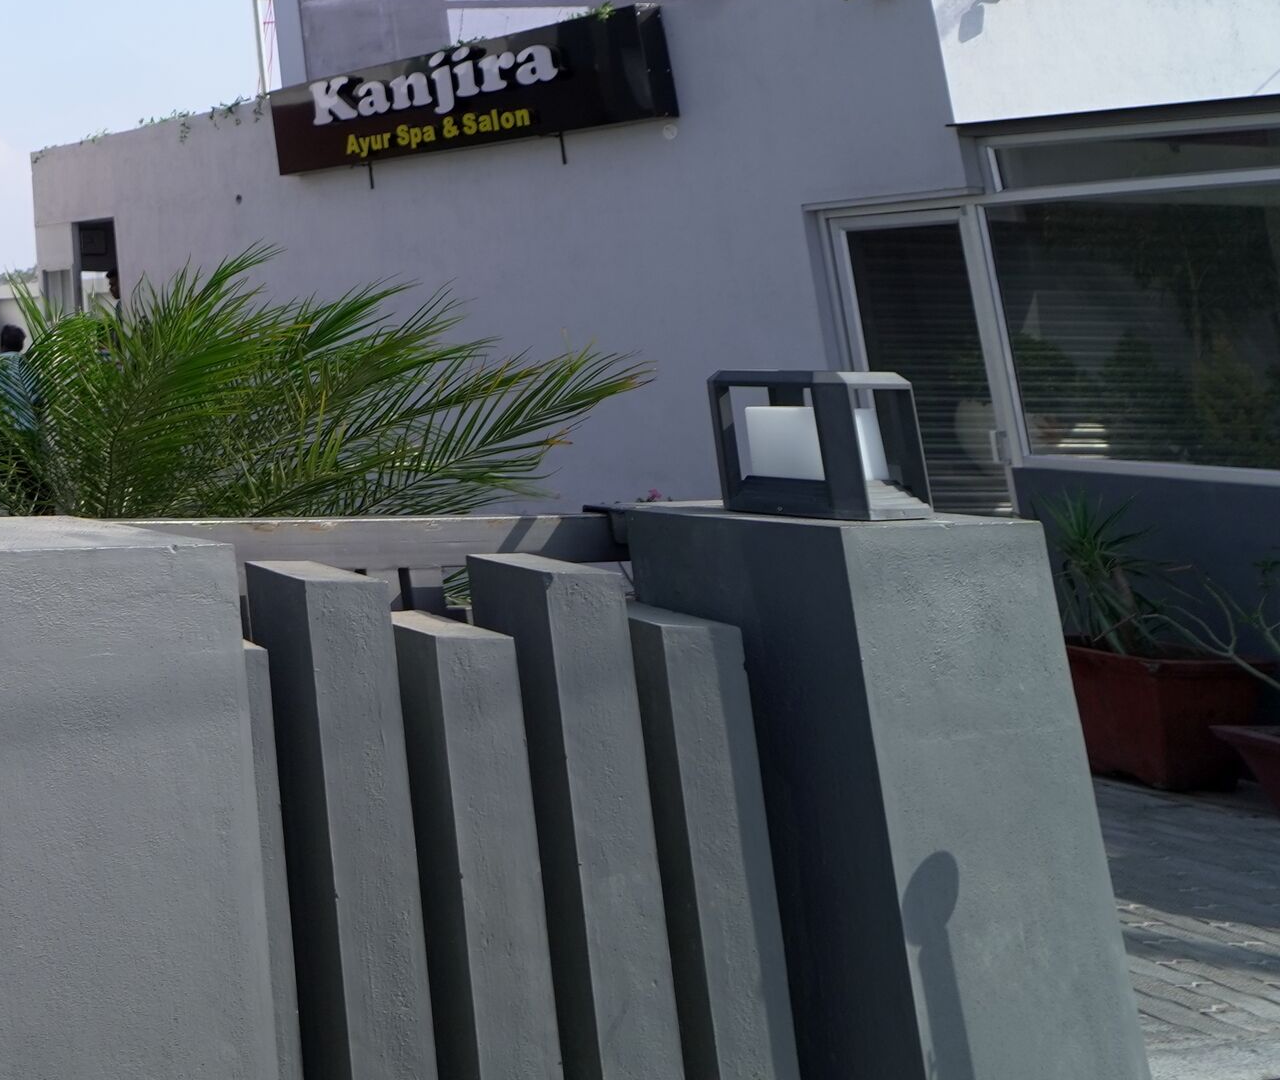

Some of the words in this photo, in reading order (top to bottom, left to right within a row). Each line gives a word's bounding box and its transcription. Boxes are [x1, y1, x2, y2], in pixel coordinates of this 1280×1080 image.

[309, 44, 559, 126] Kanjira
[346, 132, 392, 158] Ayur
[396, 123, 437, 150] Spa
[442, 117, 460, 139] &
[463, 107, 531, 135] Salon
